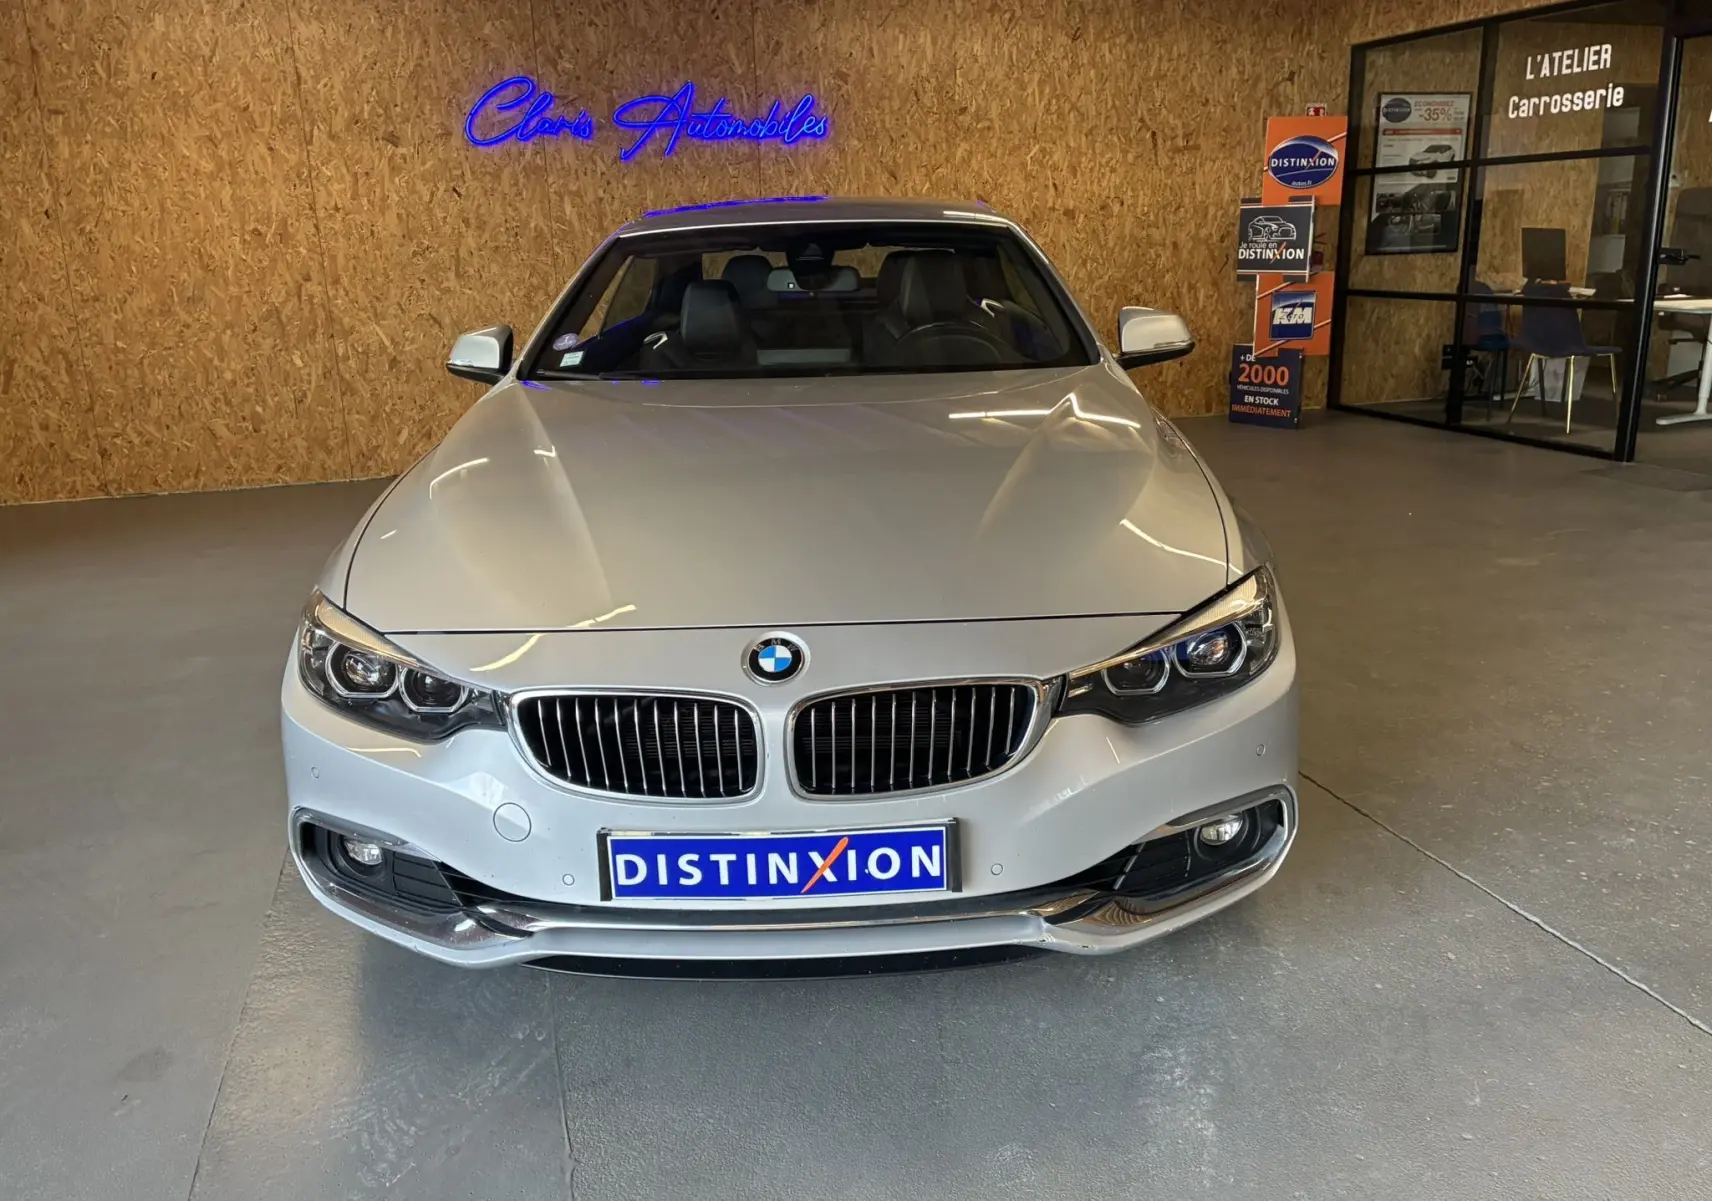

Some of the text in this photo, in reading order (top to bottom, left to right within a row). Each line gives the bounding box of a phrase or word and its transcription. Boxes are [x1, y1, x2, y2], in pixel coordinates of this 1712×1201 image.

[1525, 44, 1612, 80] L'ATELIER
[1508, 83, 1625, 119] Carrosserie
[612, 80, 829, 161] Automobiles
[1419, 107, 1452, 121] -35%
[1271, 154, 1335, 169] DISTINXION
[1238, 244, 1305, 262] DISTINXION
[1272, 307, 1313, 324] KM
[1238, 363, 1289, 386] 2000
[1244, 395, 1279, 406] EN STOCK
[615, 837, 941, 894] DISTINXION
